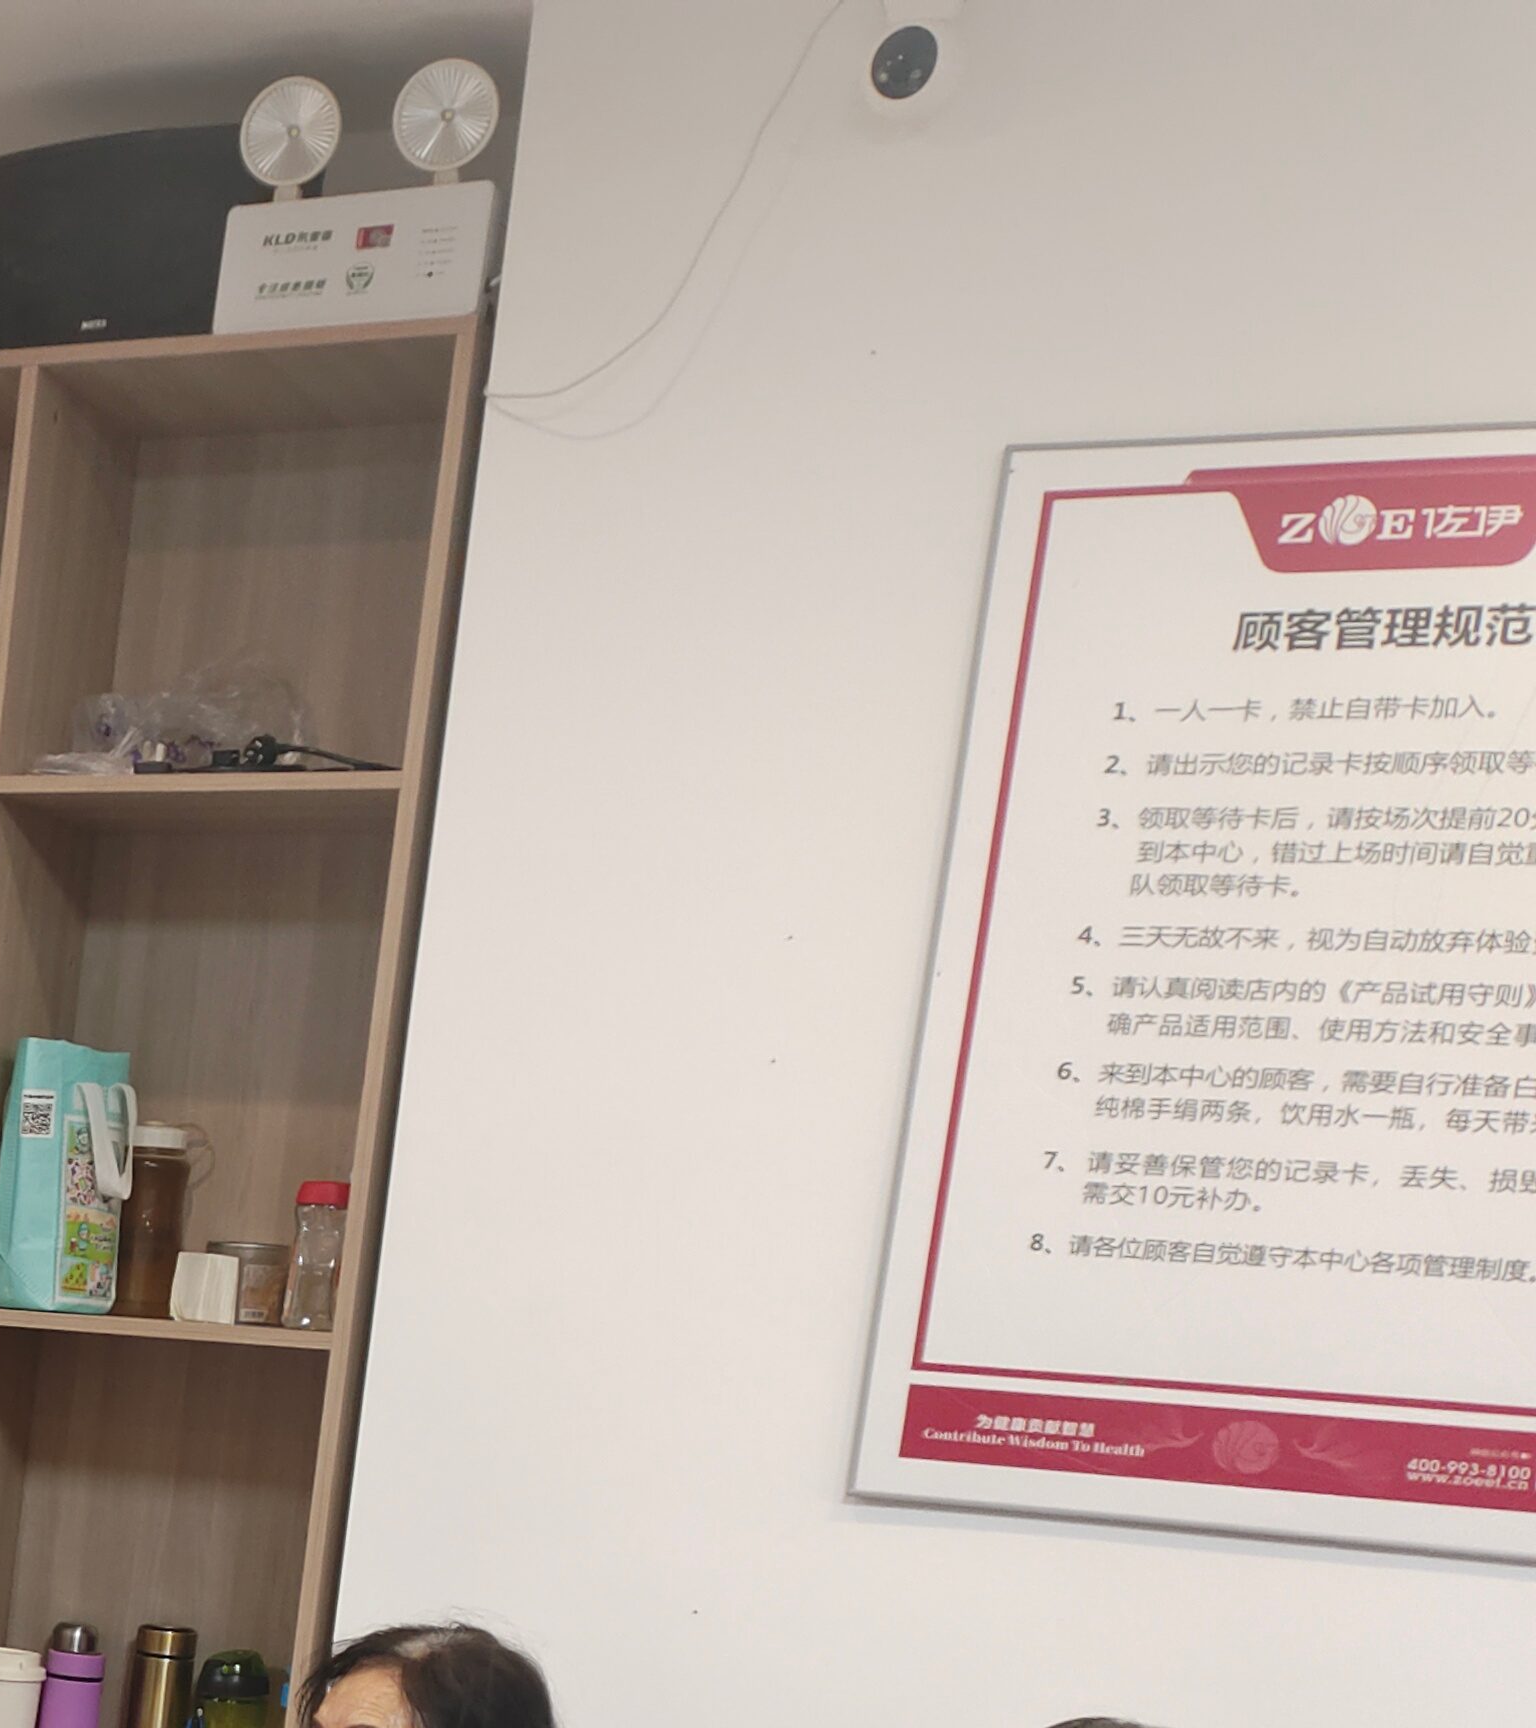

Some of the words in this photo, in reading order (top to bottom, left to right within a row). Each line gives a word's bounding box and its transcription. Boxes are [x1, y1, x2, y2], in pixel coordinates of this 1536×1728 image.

[1421, 503, 1524, 540] 佐伊
[1232, 602, 1536, 652] 顾客管理规范
[1104, 750, 1536, 776] 2、请出示您的记录卡按顺序领取等
[1097, 806, 1536, 831] 3、领取等待卡后，请按场次提前20
[1130, 873, 1301, 898] 队领取等待卡。
[1078, 925, 1536, 955] 4、三天无故不来，视为自动放弃体验
[1082, 1182, 1261, 1212] 需交10元补办。
[923, 1427, 1005, 1446] Contribute
[1008, 1434, 1069, 1451] Wisdom
[1071, 1440, 1090, 1452] To
[1093, 1442, 1146, 1458] Health
[1407, 1458, 1532, 1481] 400-993-8100
